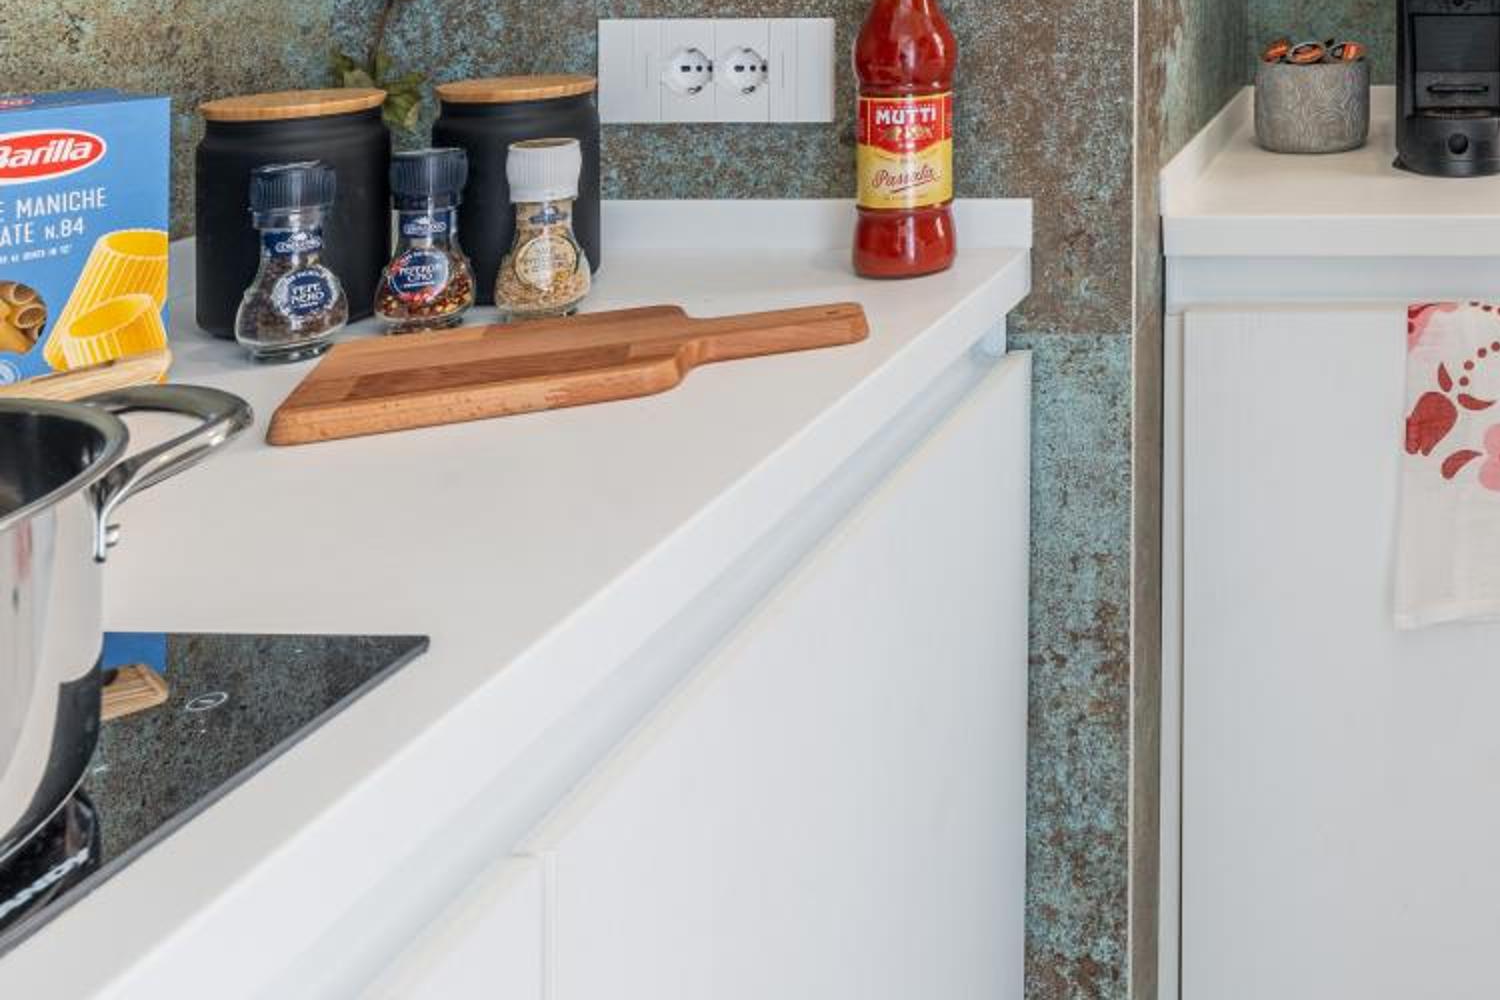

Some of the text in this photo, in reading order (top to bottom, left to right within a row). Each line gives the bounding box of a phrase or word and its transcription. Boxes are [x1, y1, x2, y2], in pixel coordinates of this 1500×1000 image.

[875, 106, 937, 126] MUTTI
[16, 187, 107, 220] MANICHE
[45, 216, 84, 241] N.84
